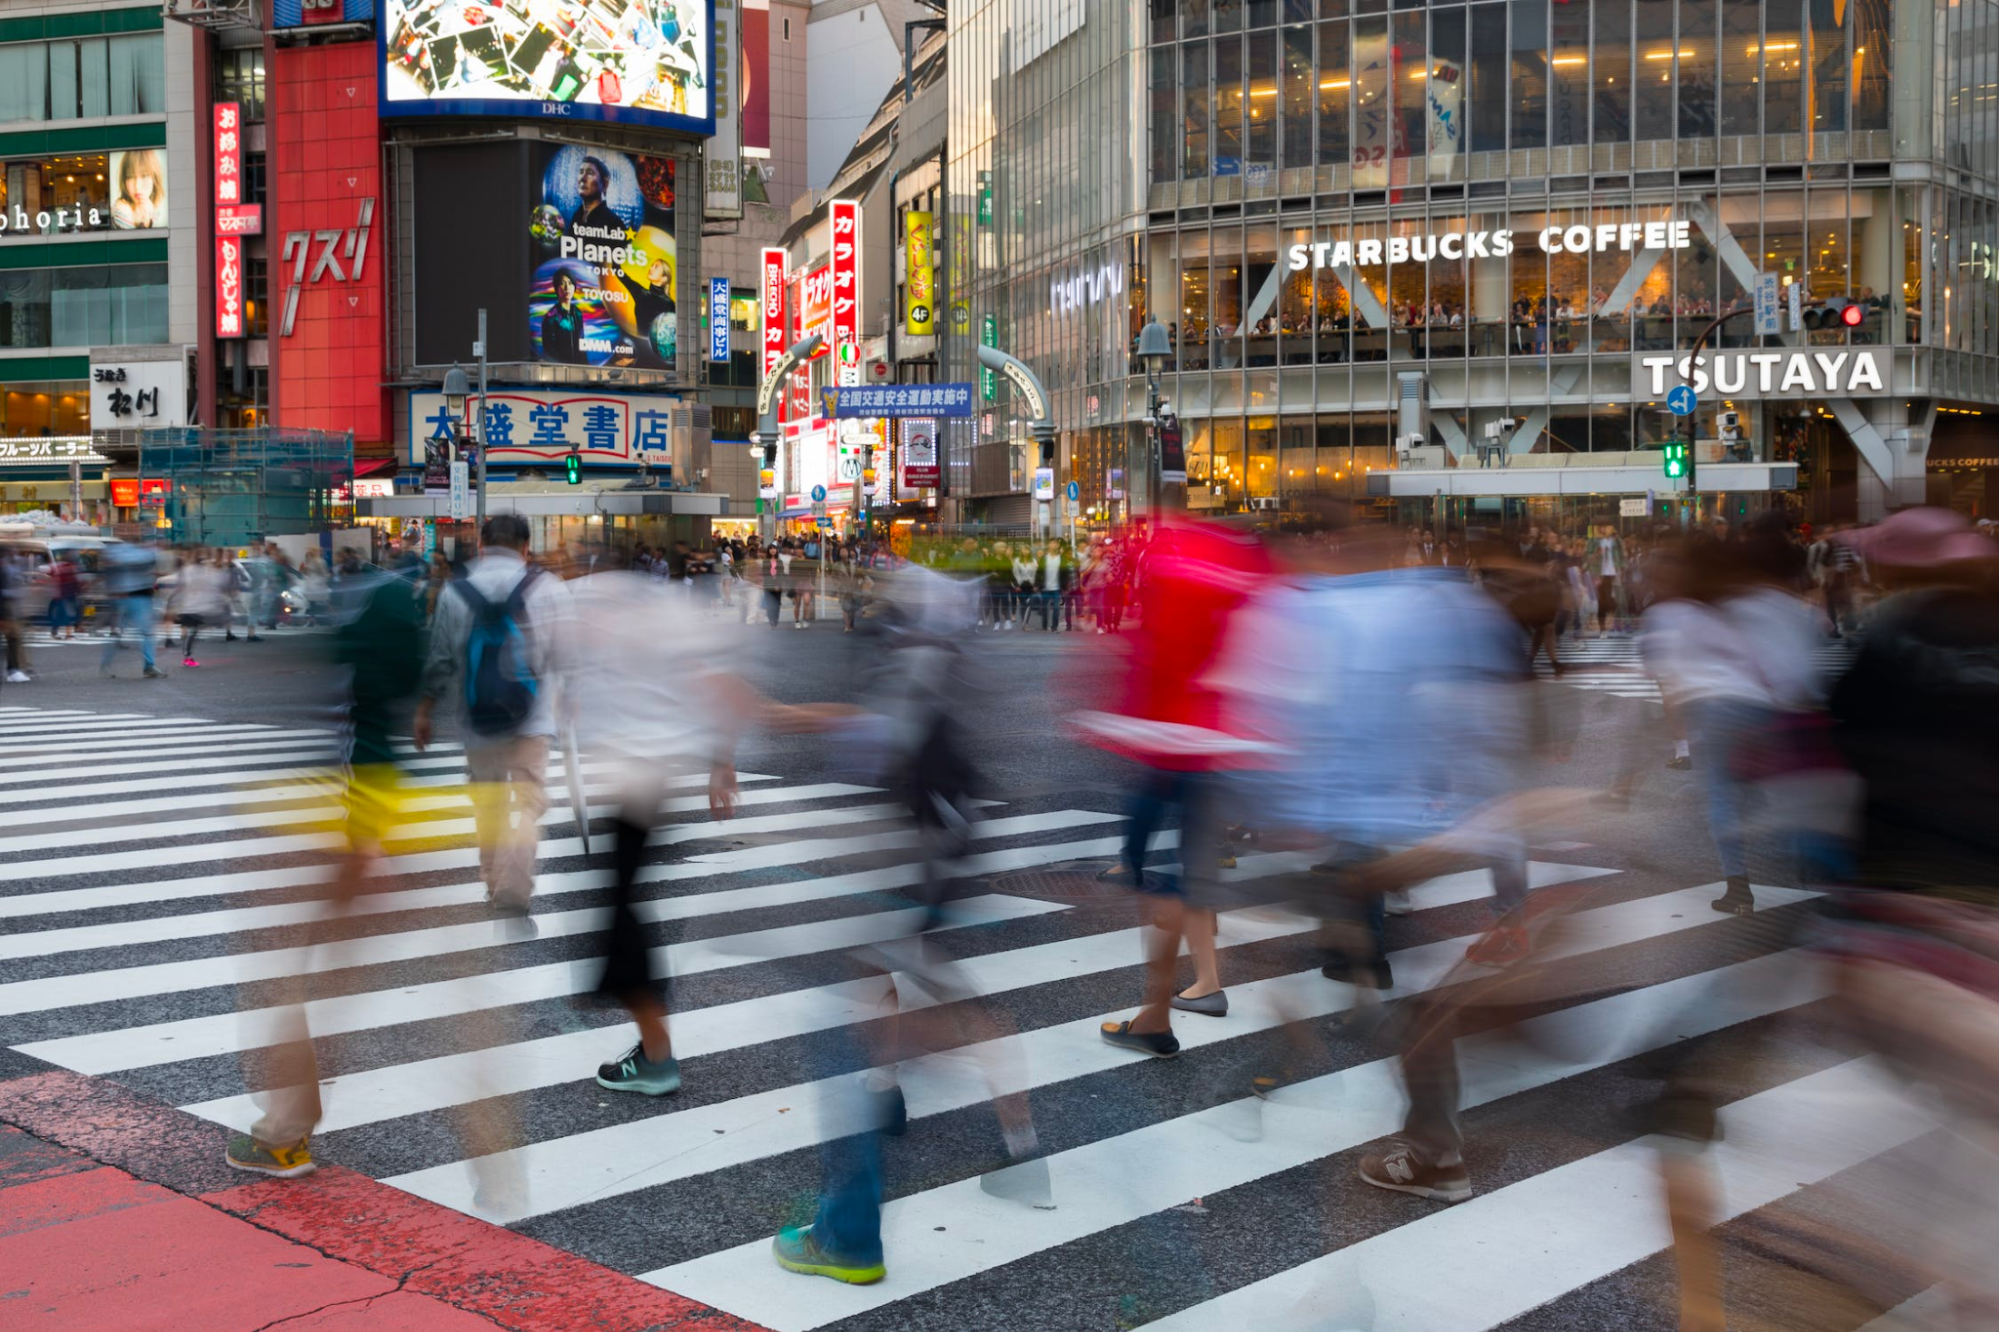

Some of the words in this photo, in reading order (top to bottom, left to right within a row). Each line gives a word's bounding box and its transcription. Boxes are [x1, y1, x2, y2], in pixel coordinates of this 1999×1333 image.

[542, 102, 571, 115] DHC
[572, 222, 625, 240] teamLab
[1288, 229, 1514, 271] STARBUCKS
[1538, 220, 1691, 254] COFFEE
[280, 197, 375, 336] クスリ
[560, 235, 648, 267] Planets
[835, 215, 854, 314] カラオケ
[585, 266, 625, 278] TOKYO
[767, 264, 778, 285] BIG
[582, 288, 629, 303] TOYOSU
[767, 286, 778, 317] ECHO
[714, 282, 726, 357] 大盛堂商事ビル
[912, 307, 928, 320] 4F
[579, 338, 634, 355] DMM.com
[1643, 352, 1883, 395] TSUTAYA
[107, 387, 158, 418] 松川
[839, 388, 968, 407] 全国交通安全運動実施中
[425, 403, 669, 452] 大盛堂書店
